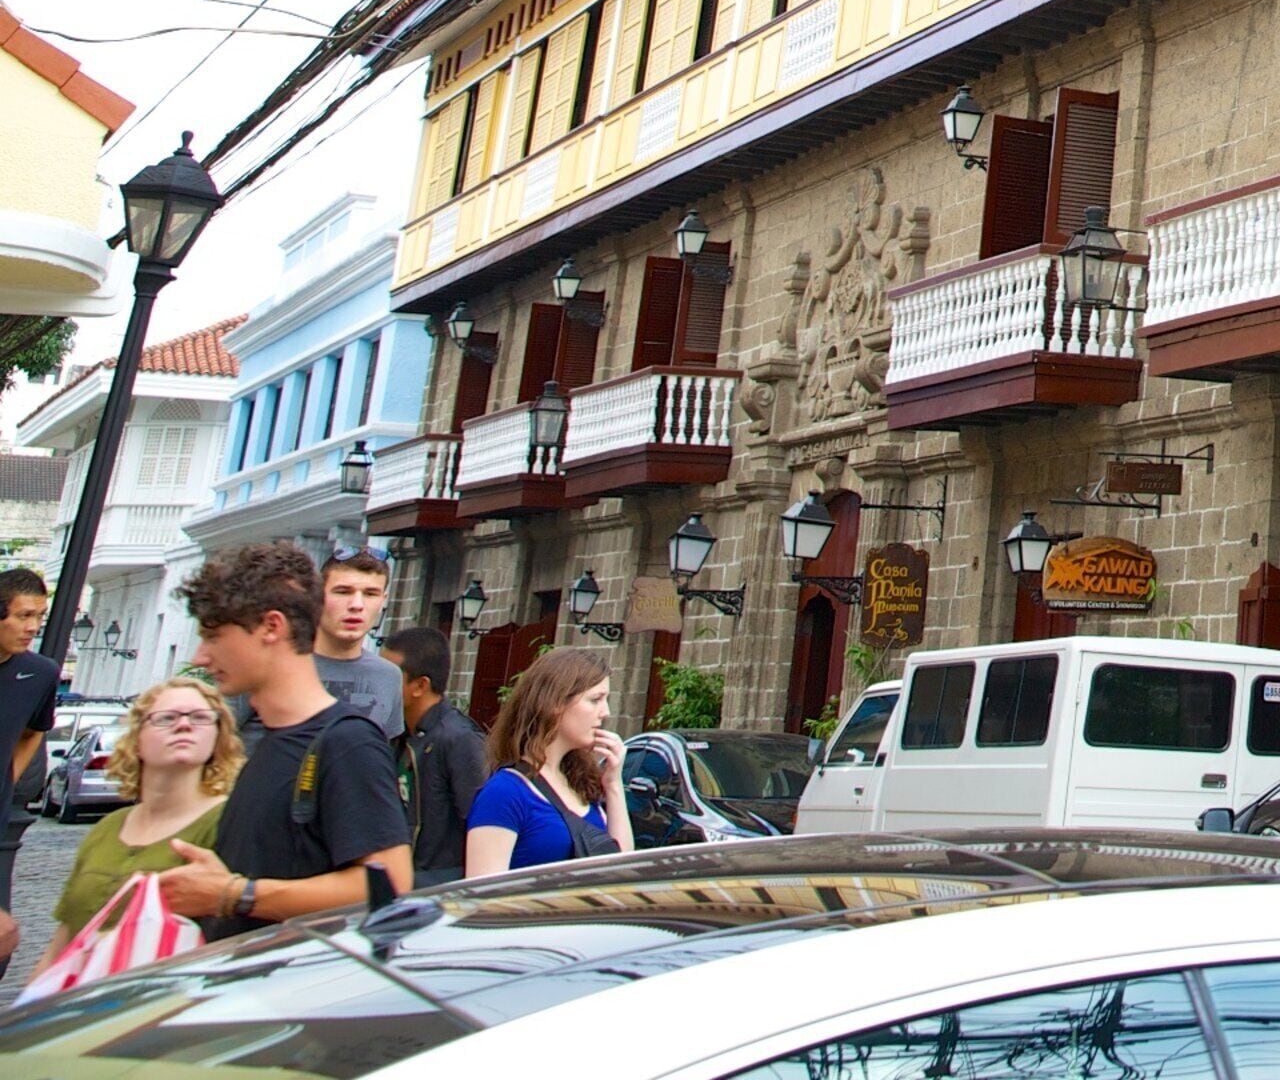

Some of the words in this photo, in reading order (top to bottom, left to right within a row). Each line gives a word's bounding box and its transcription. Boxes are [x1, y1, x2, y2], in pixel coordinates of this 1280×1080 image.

[871, 558, 908, 579] Casa
[1083, 557, 1153, 577] GAWAD
[864, 579, 922, 609] Manila
